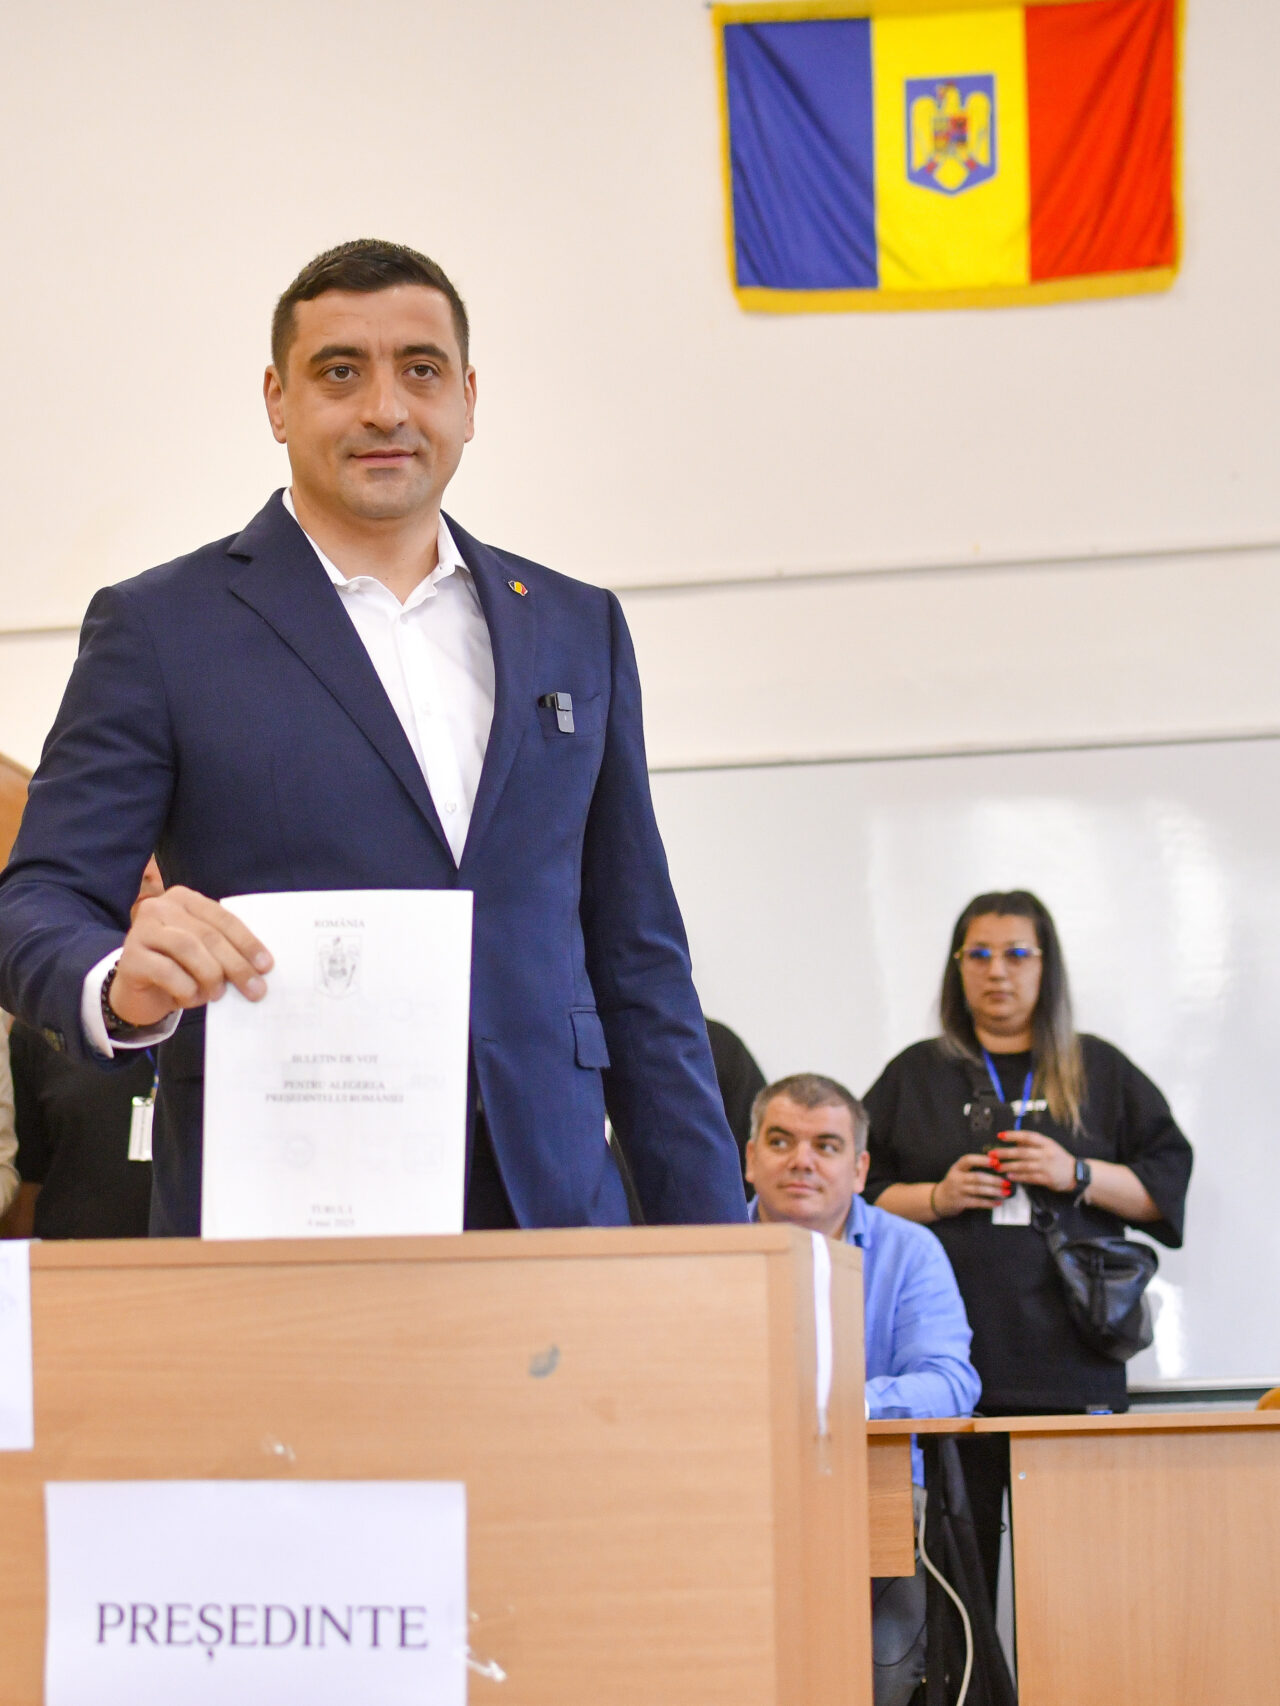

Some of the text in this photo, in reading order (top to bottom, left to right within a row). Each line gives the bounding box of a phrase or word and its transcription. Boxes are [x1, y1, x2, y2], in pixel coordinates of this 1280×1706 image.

[291, 1053, 379, 1064] BULETIN DE VOT
[283, 1079, 386, 1090] PENTRU ALEGEREA
[95, 1600, 430, 1661] PREȘEDINTE
